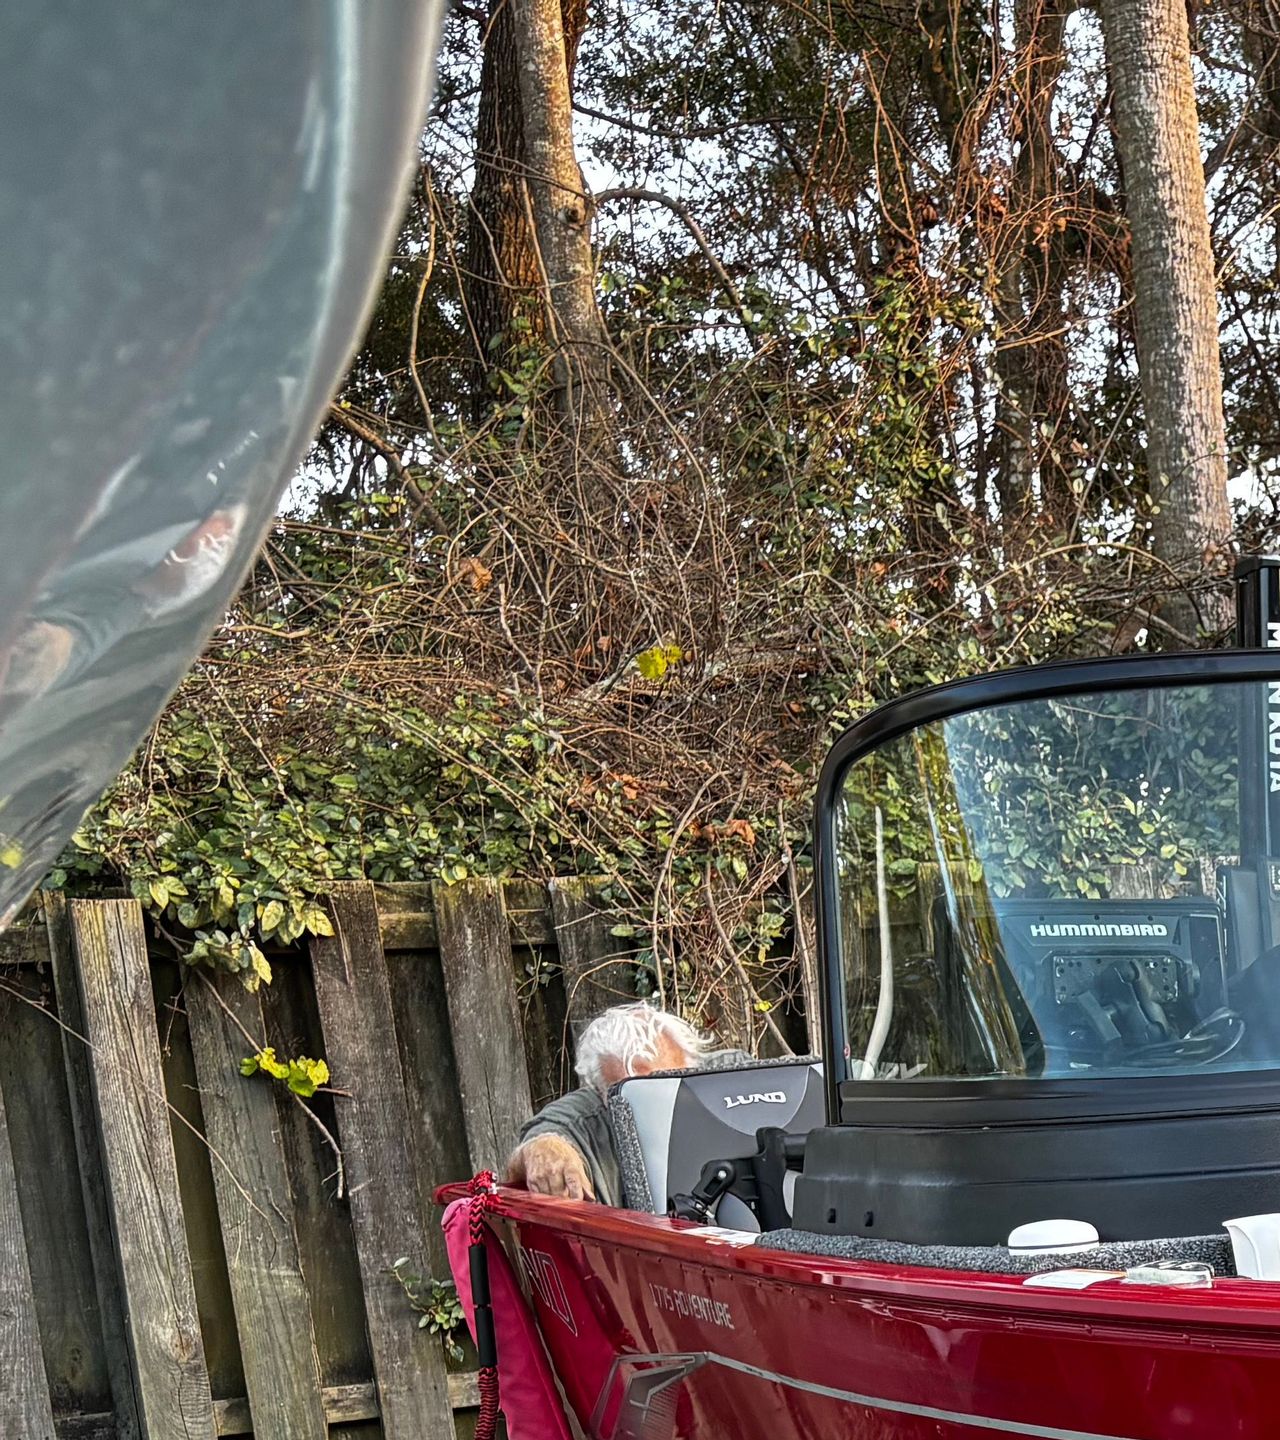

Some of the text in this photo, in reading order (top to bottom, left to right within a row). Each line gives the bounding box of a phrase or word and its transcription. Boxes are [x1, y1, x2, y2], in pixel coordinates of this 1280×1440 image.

[1030, 924, 1168, 937] HUMMINBIRD
[723, 1091, 787, 1109] LUND
[672, 1289, 736, 1330] ADVENTURE
